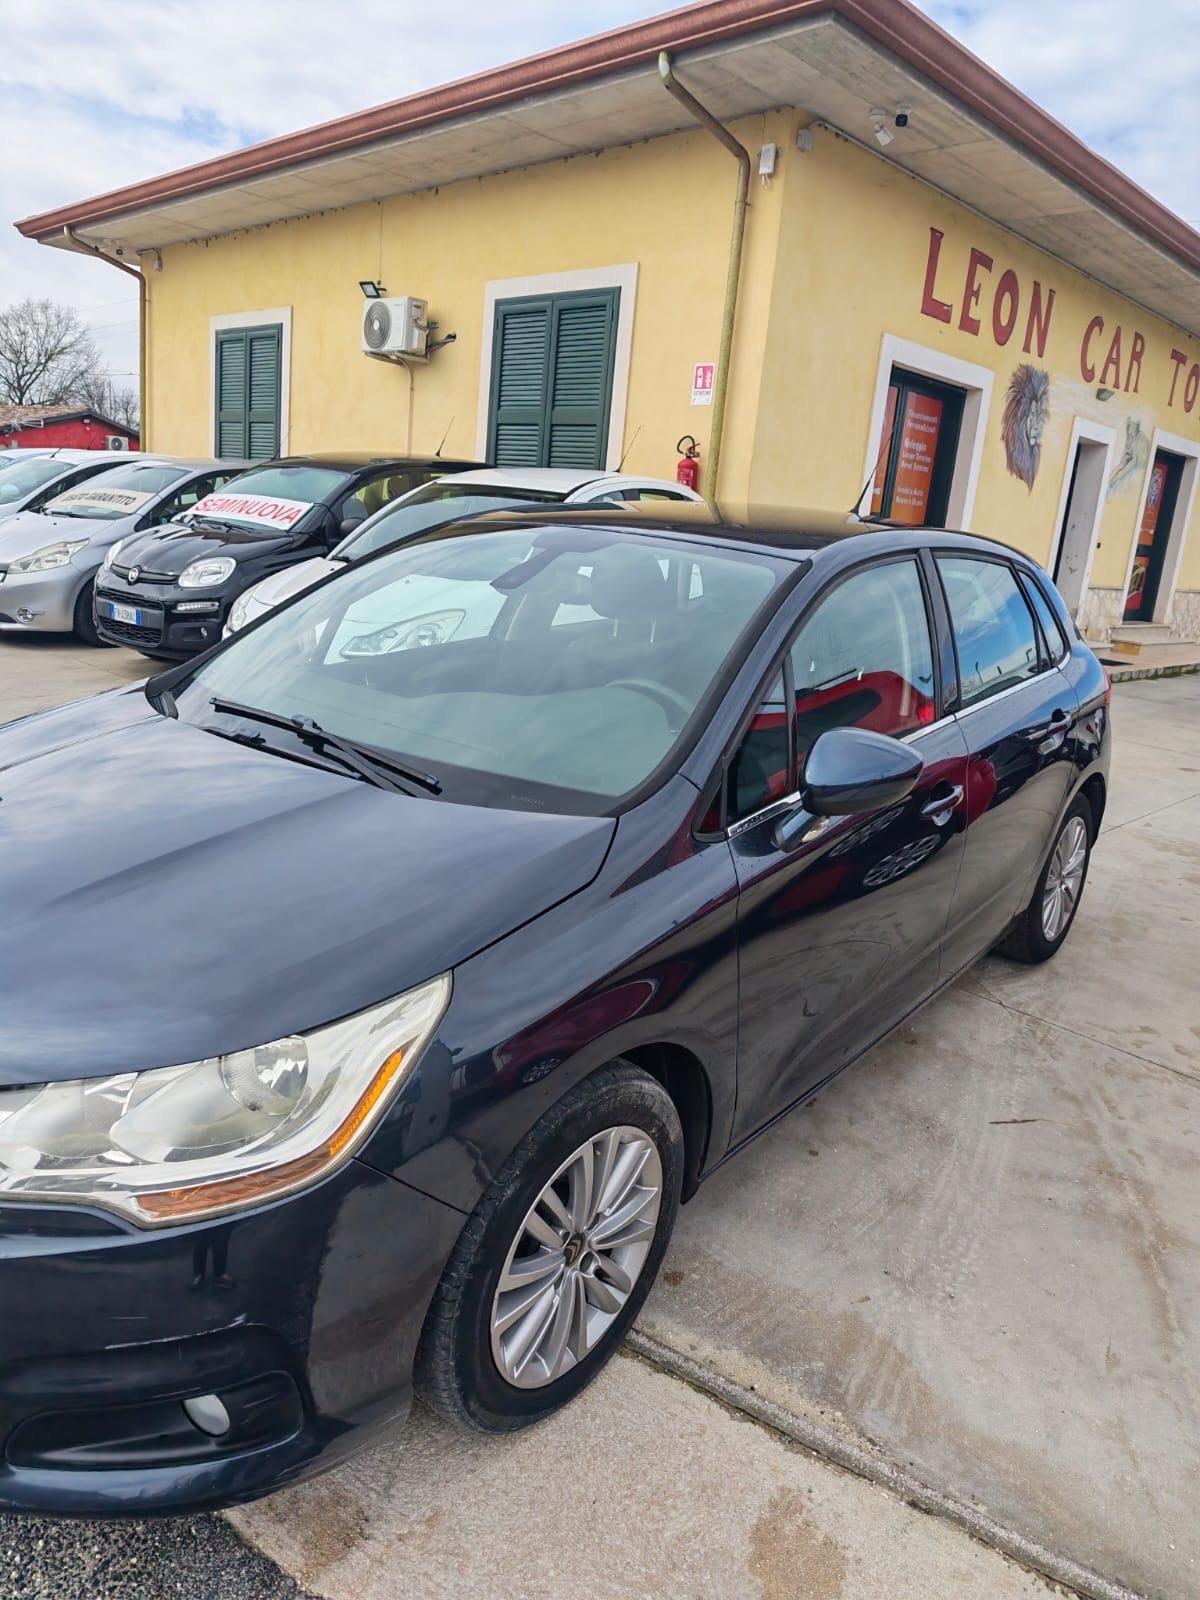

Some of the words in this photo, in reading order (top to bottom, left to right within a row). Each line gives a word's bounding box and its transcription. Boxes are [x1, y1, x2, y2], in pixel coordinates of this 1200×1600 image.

[921, 226, 1056, 358] LEON
[1080, 315, 1146, 393] CAR
[1167, 348, 1200, 414] TO
[196, 498, 303, 523] SEMINUOVA
